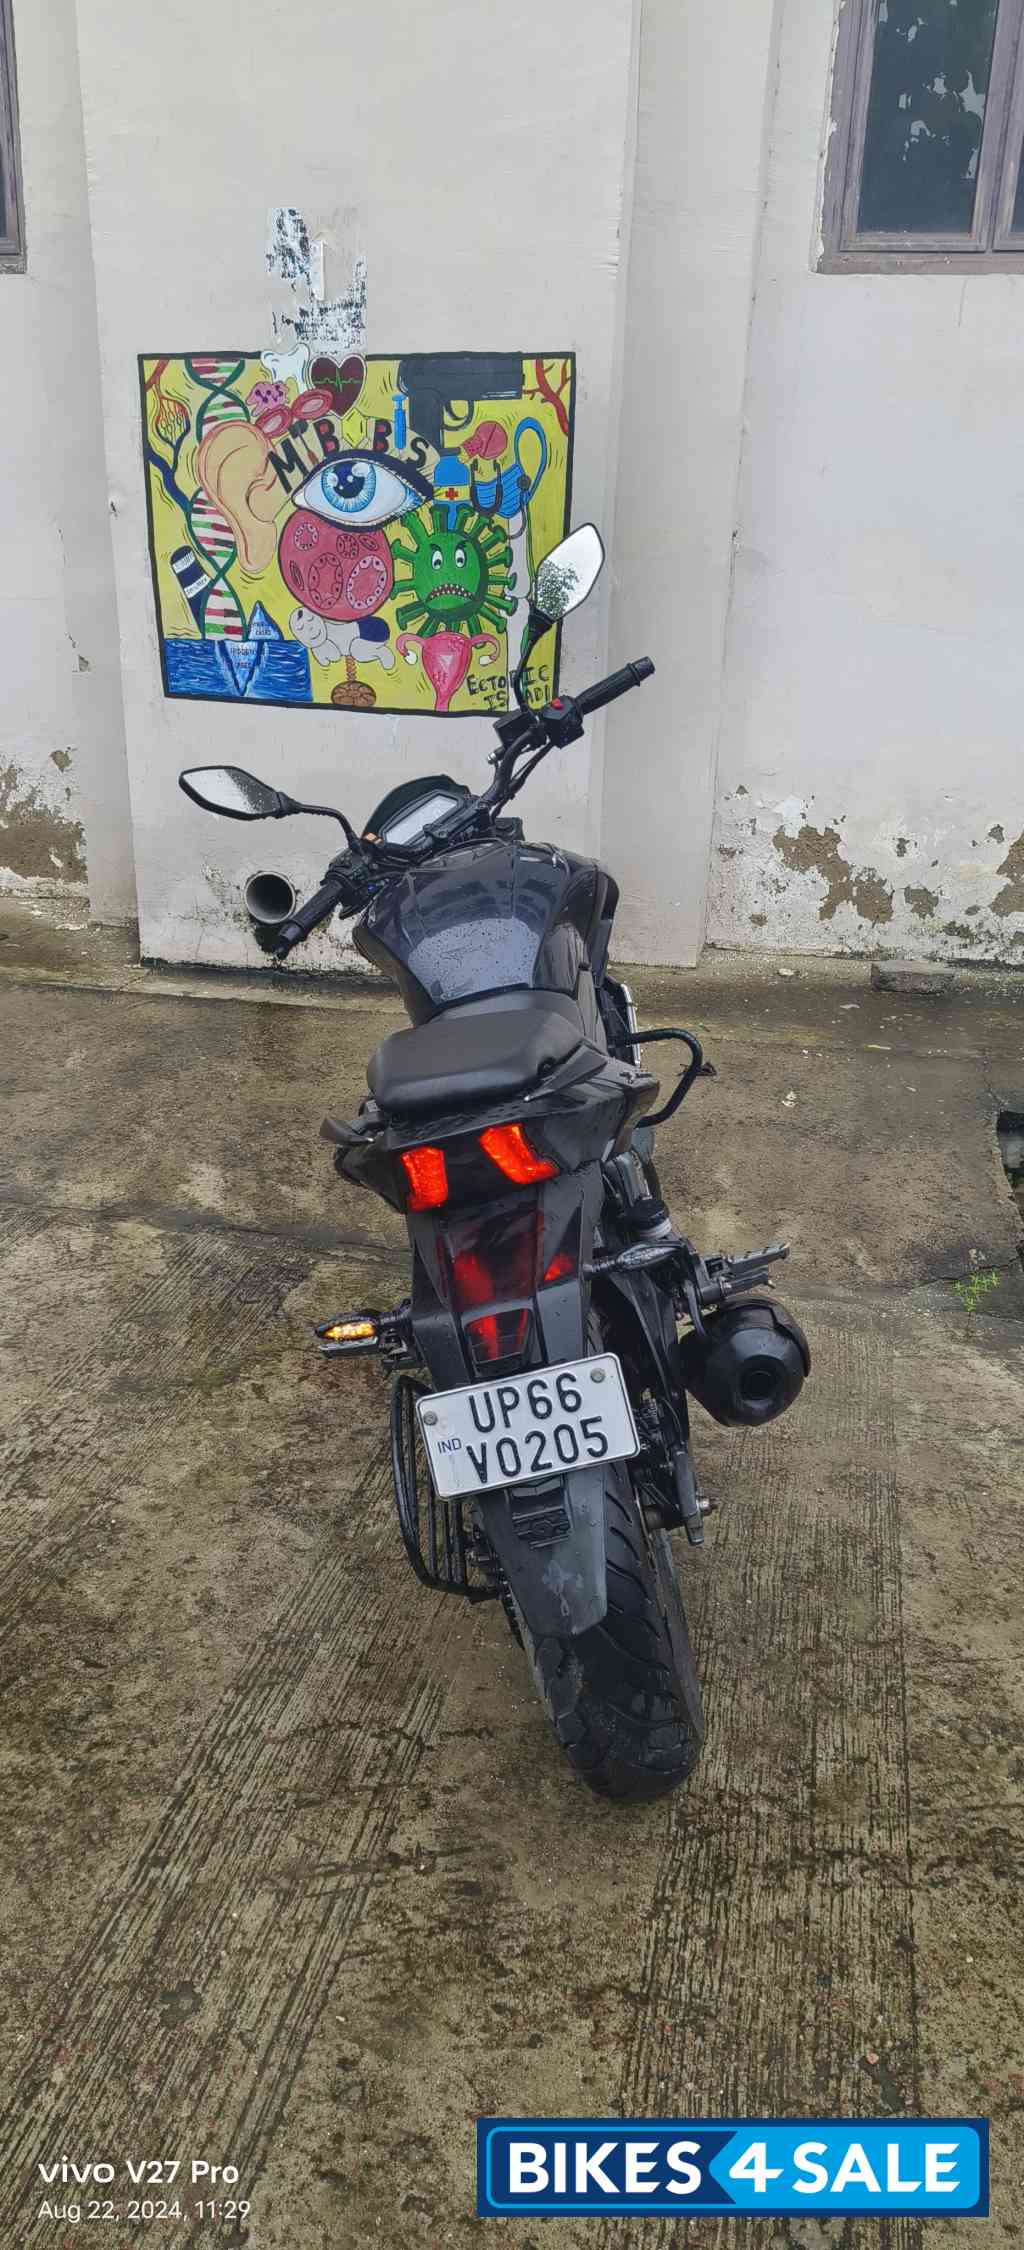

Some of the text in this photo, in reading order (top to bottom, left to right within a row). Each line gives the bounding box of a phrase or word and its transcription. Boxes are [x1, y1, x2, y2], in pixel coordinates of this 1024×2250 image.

[468, 1372, 582, 1433] UP66
[437, 1437, 462, 1454] IND
[466, 1415, 609, 1484] V0205
